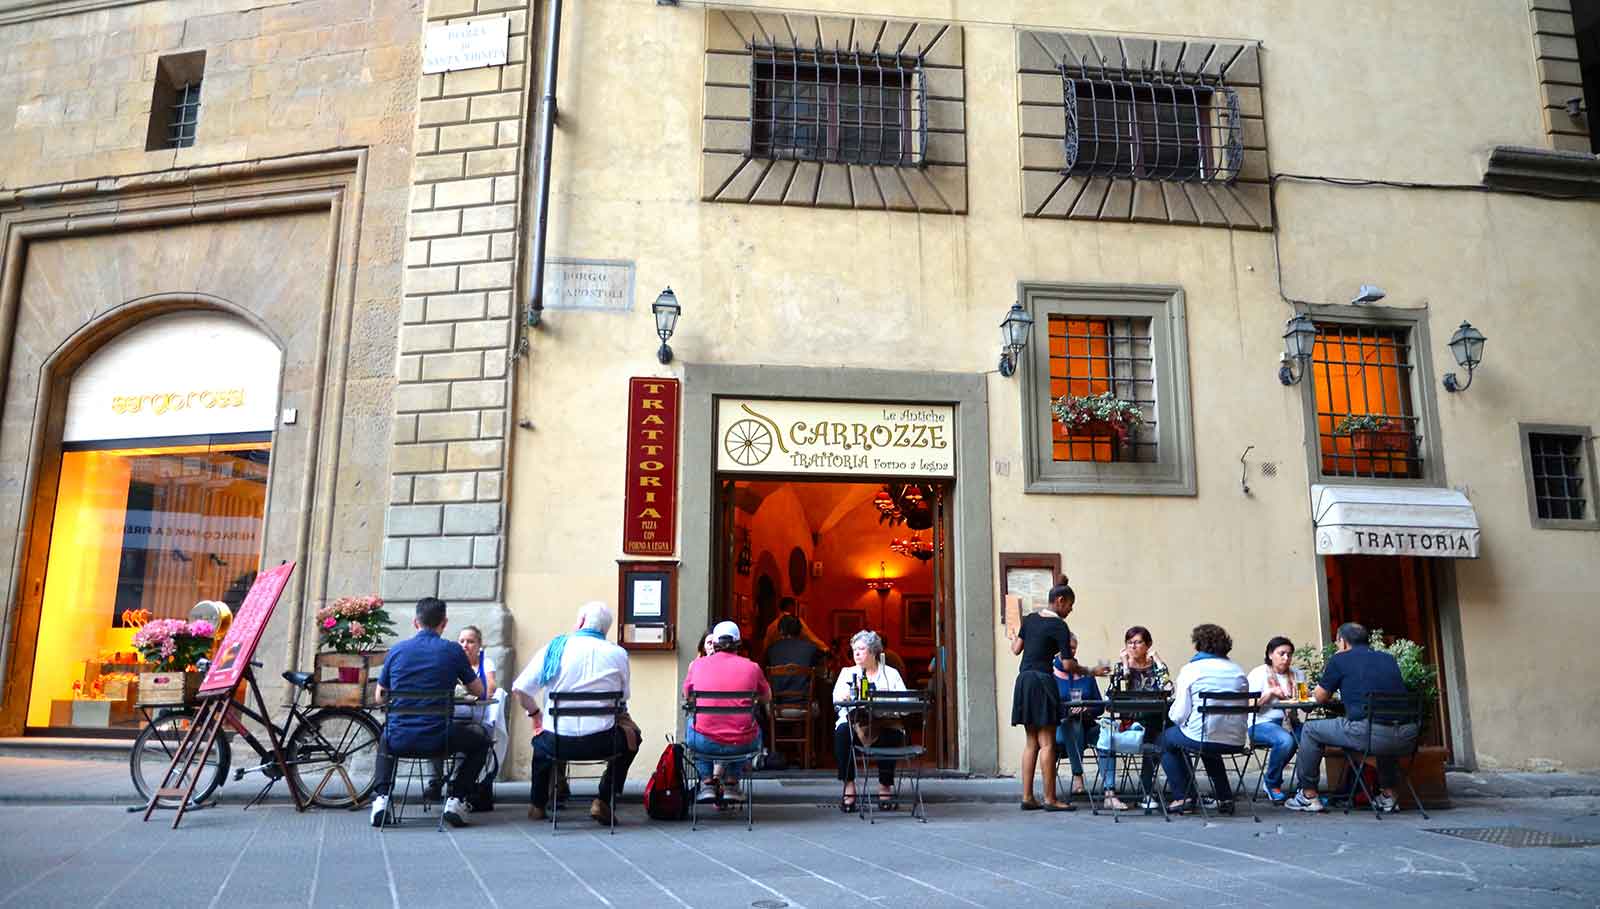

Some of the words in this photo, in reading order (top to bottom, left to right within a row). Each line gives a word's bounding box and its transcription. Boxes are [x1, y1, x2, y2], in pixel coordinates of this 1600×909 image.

[563, 271, 608, 281] BORGO
[883, 408, 896, 421] Le
[900, 409, 946, 423] Antiche
[789, 421, 948, 451] CARROZZE
[638, 383, 666, 519] TRATTORIA
[789, 451, 869, 470] TRATTORIA
[641, 520, 657, 530] PIZZA
[643, 531, 656, 540] CON
[1354, 531, 1470, 551] TRATTORIA
